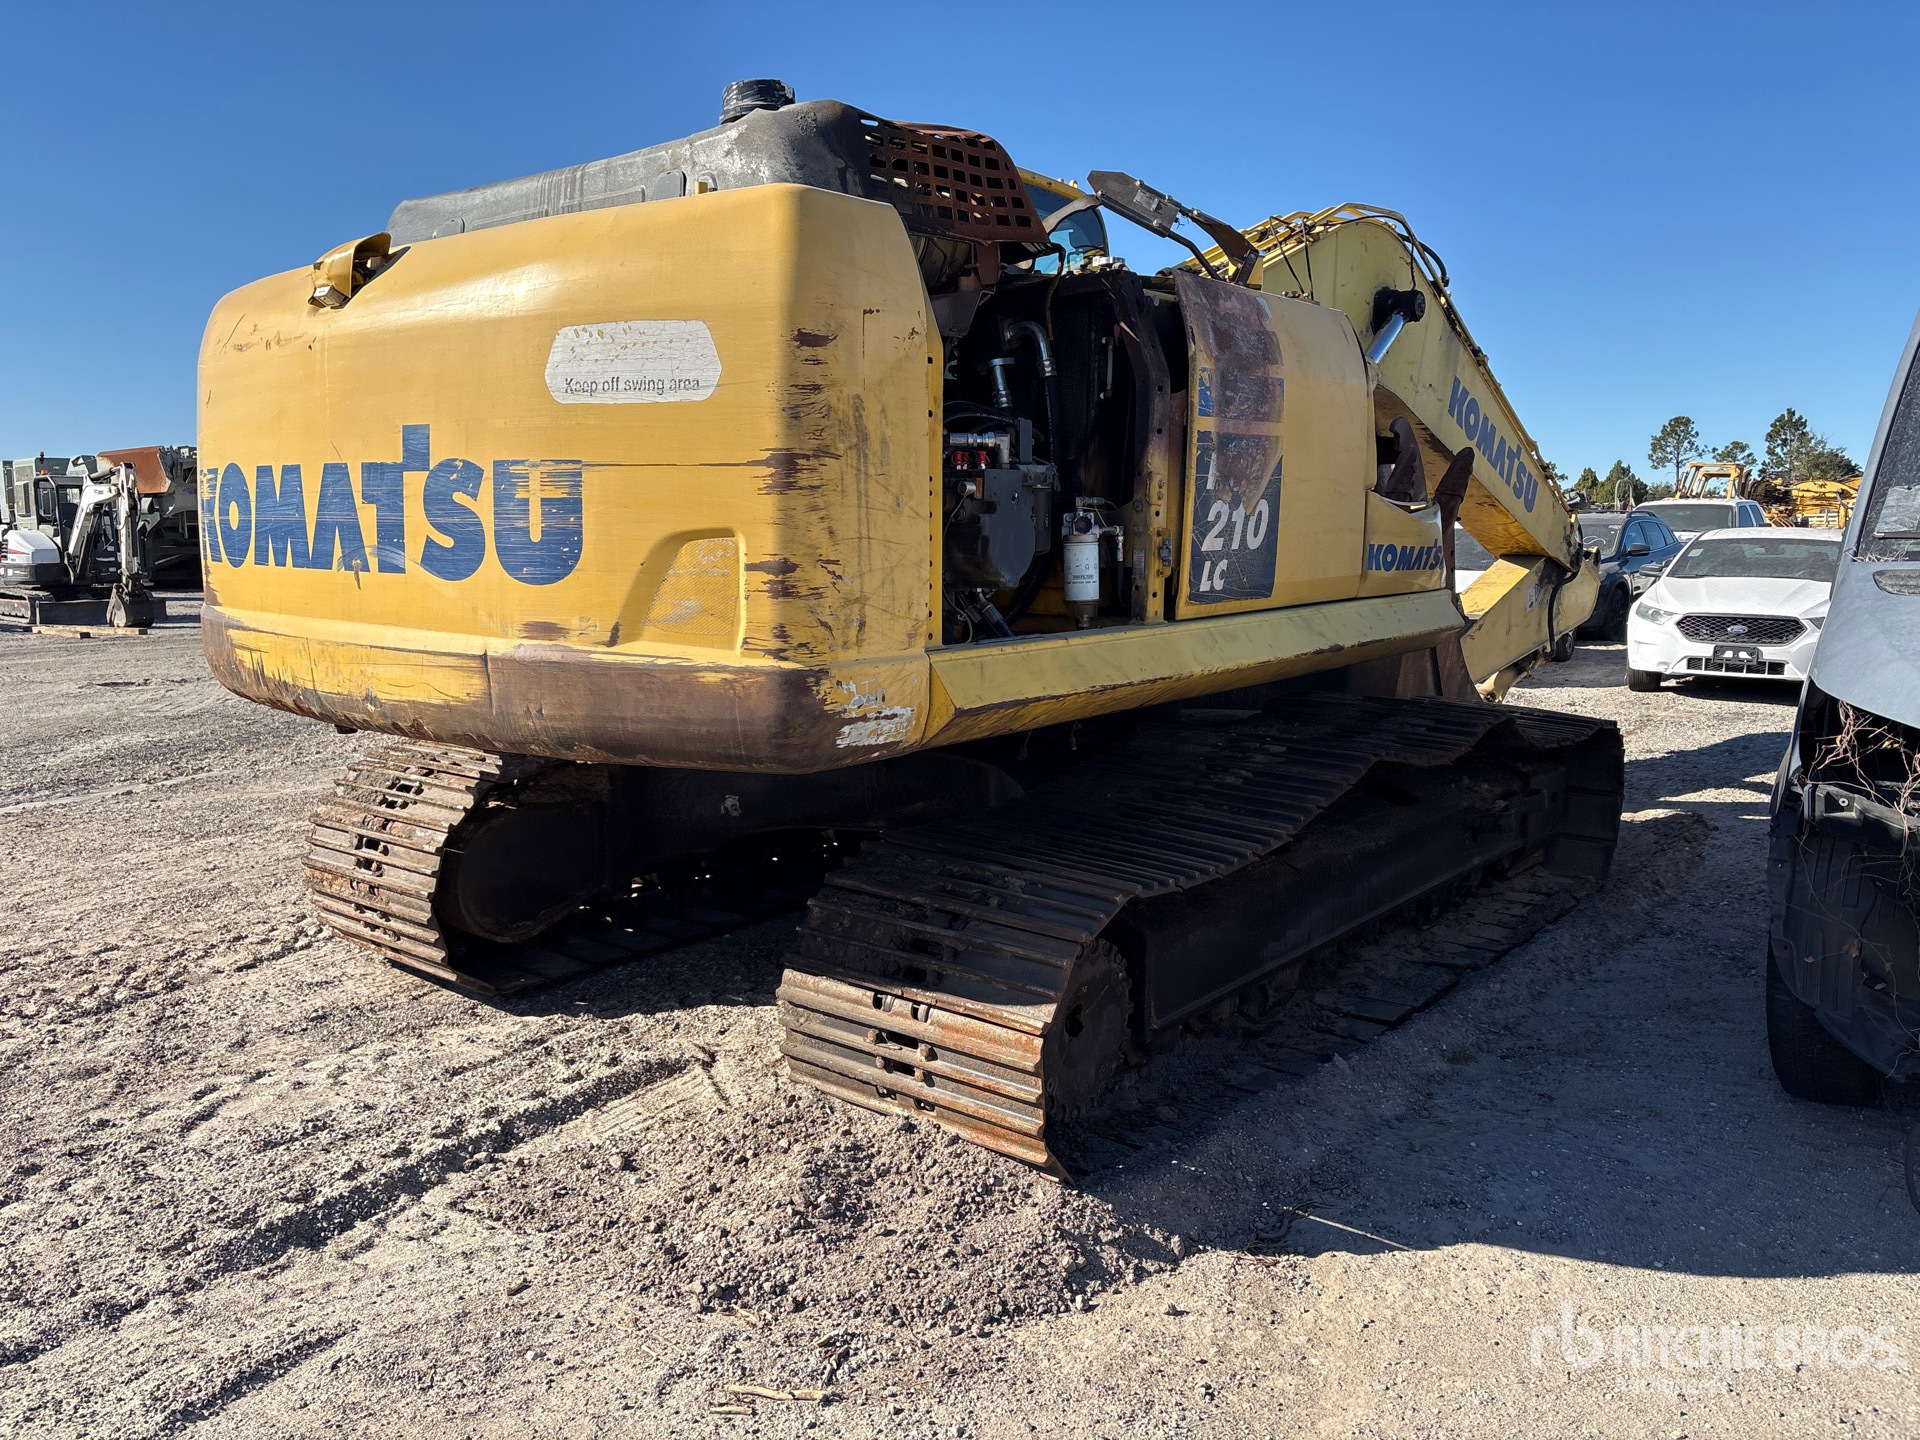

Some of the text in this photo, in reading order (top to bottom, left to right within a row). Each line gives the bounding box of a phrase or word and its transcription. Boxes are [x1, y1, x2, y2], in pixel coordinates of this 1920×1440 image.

[565, 376, 700, 396] Keep off swing area
[1448, 375, 1539, 513] KOMATSU
[200, 424, 583, 585] KOMATSU
[1201, 499, 1269, 551] 210
[1199, 559, 1228, 592] LC
[1367, 538, 1444, 571] KOMATS
